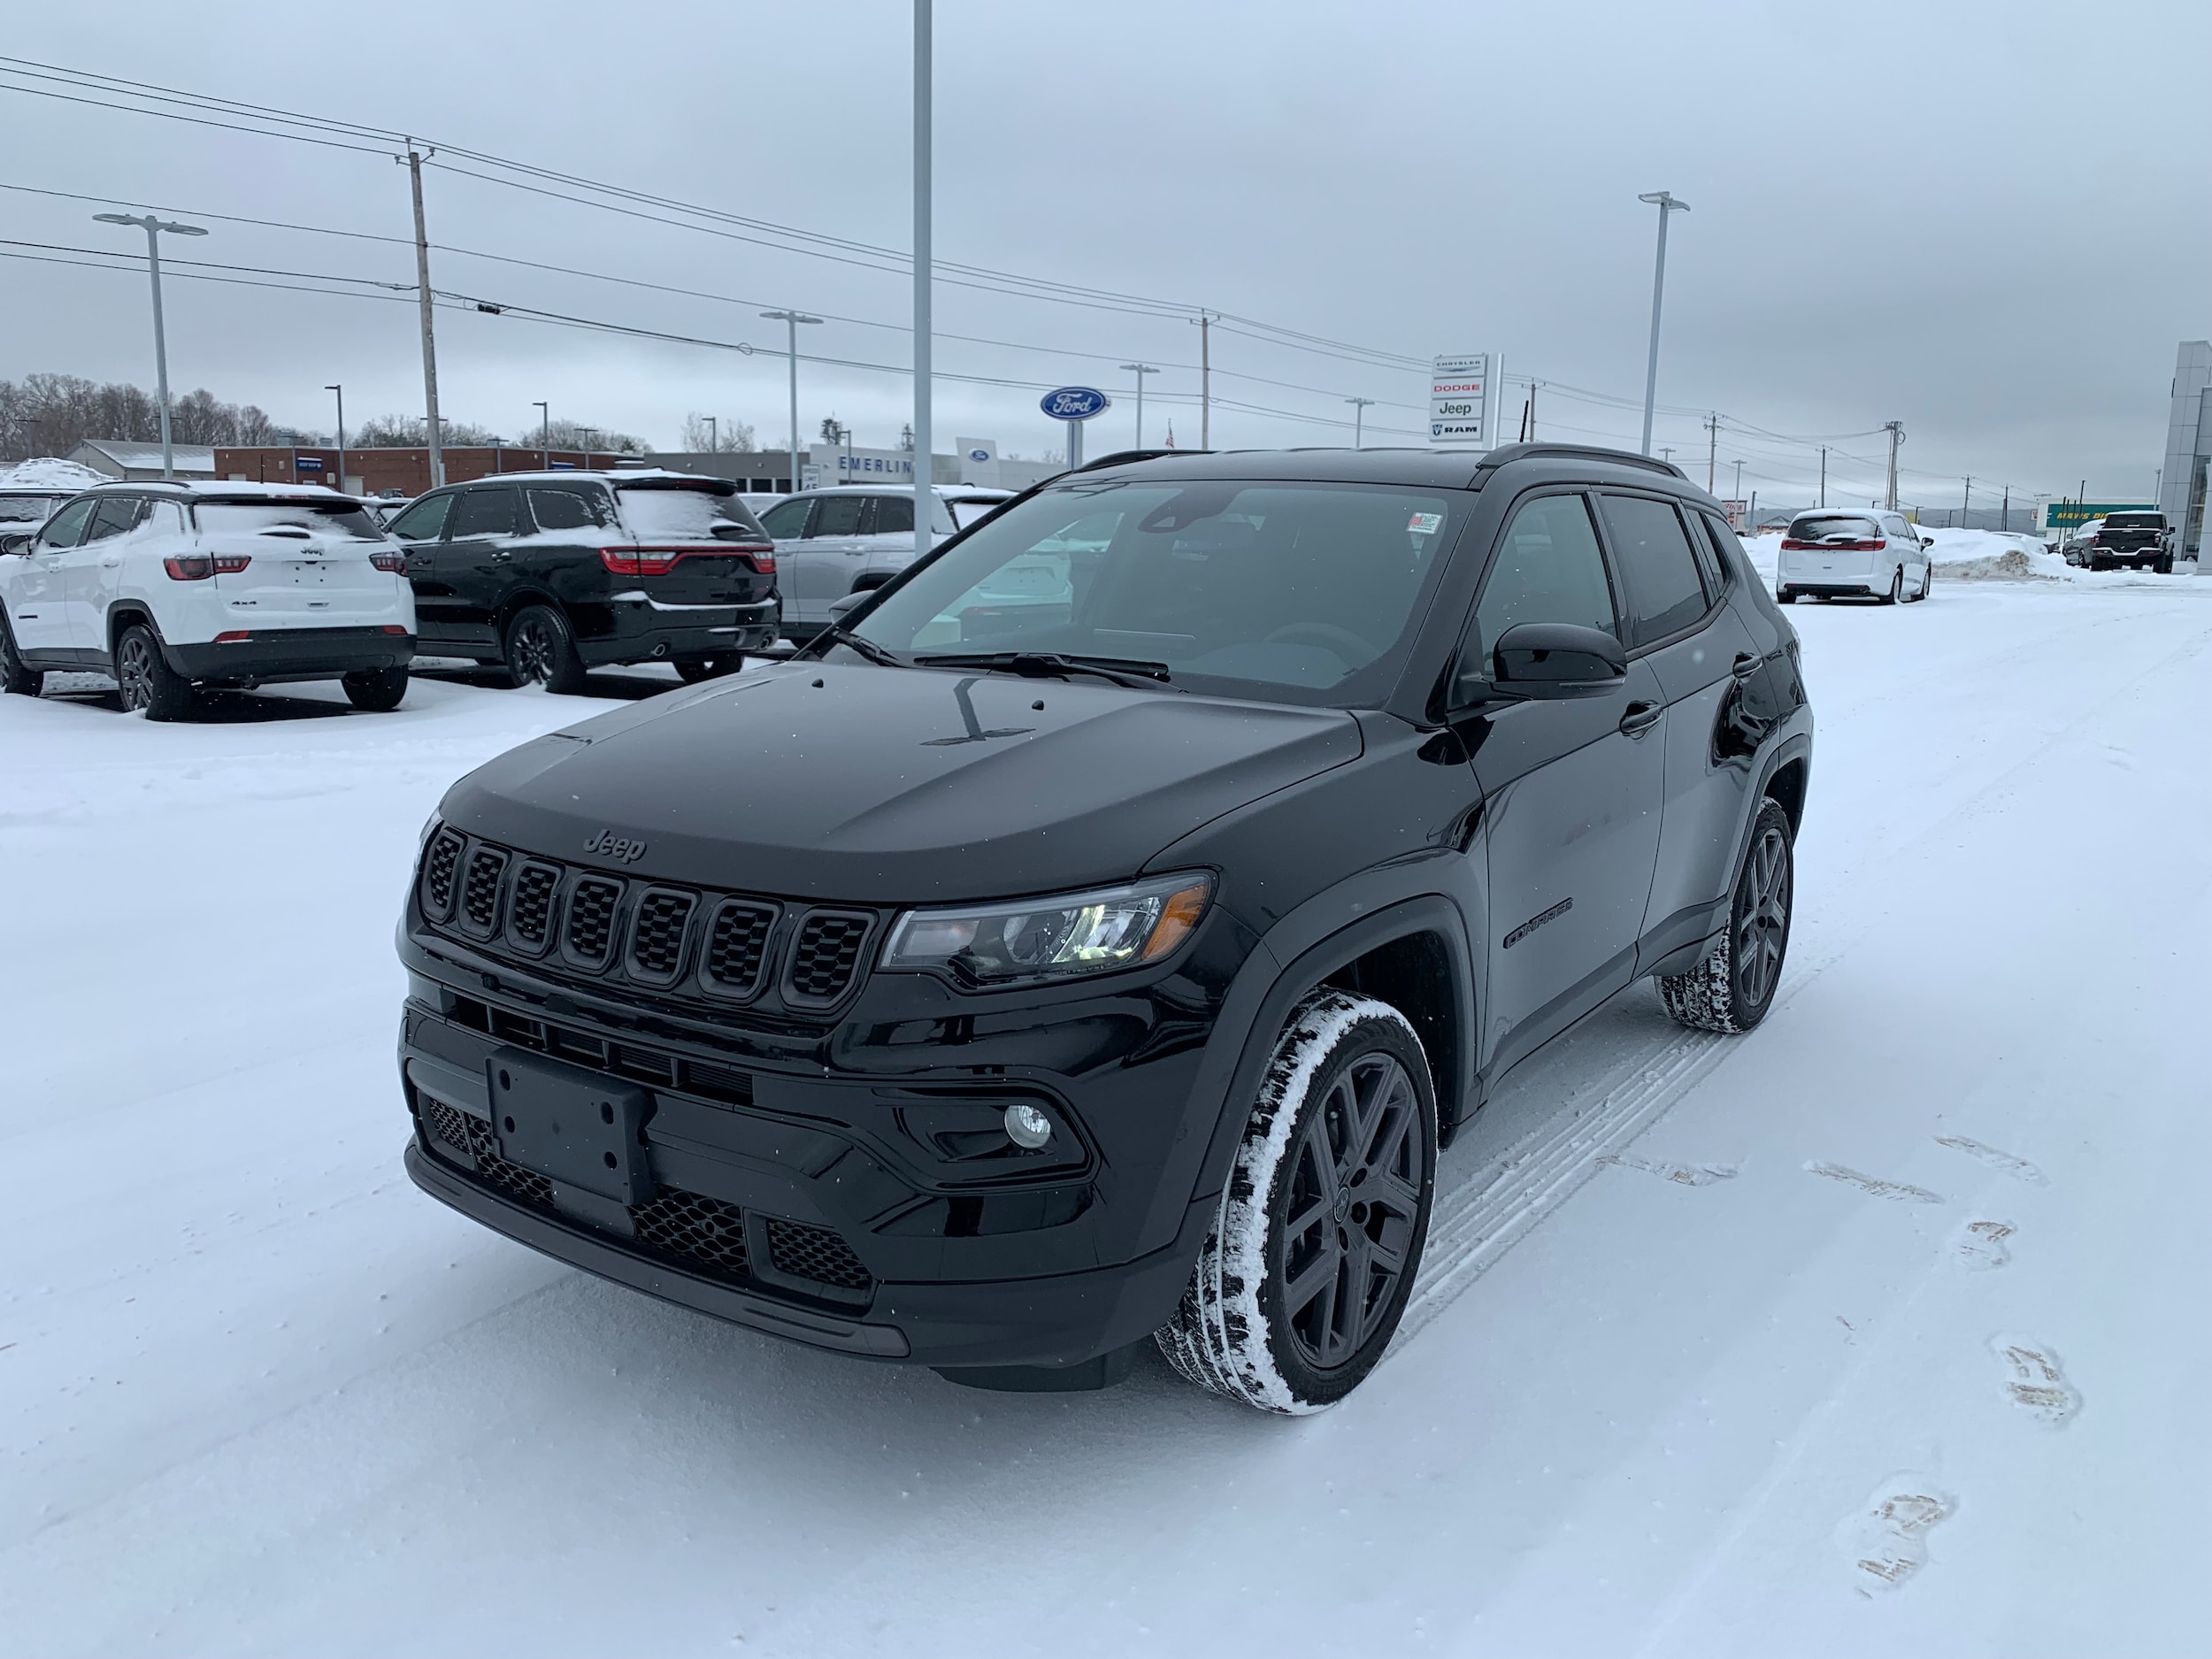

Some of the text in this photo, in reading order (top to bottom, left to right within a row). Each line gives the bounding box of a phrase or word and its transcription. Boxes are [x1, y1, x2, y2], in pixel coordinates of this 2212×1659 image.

[1052, 393, 1093, 413] Ford
[1440, 402, 1471, 416] Jeep
[583, 828, 647, 864] Jeep
